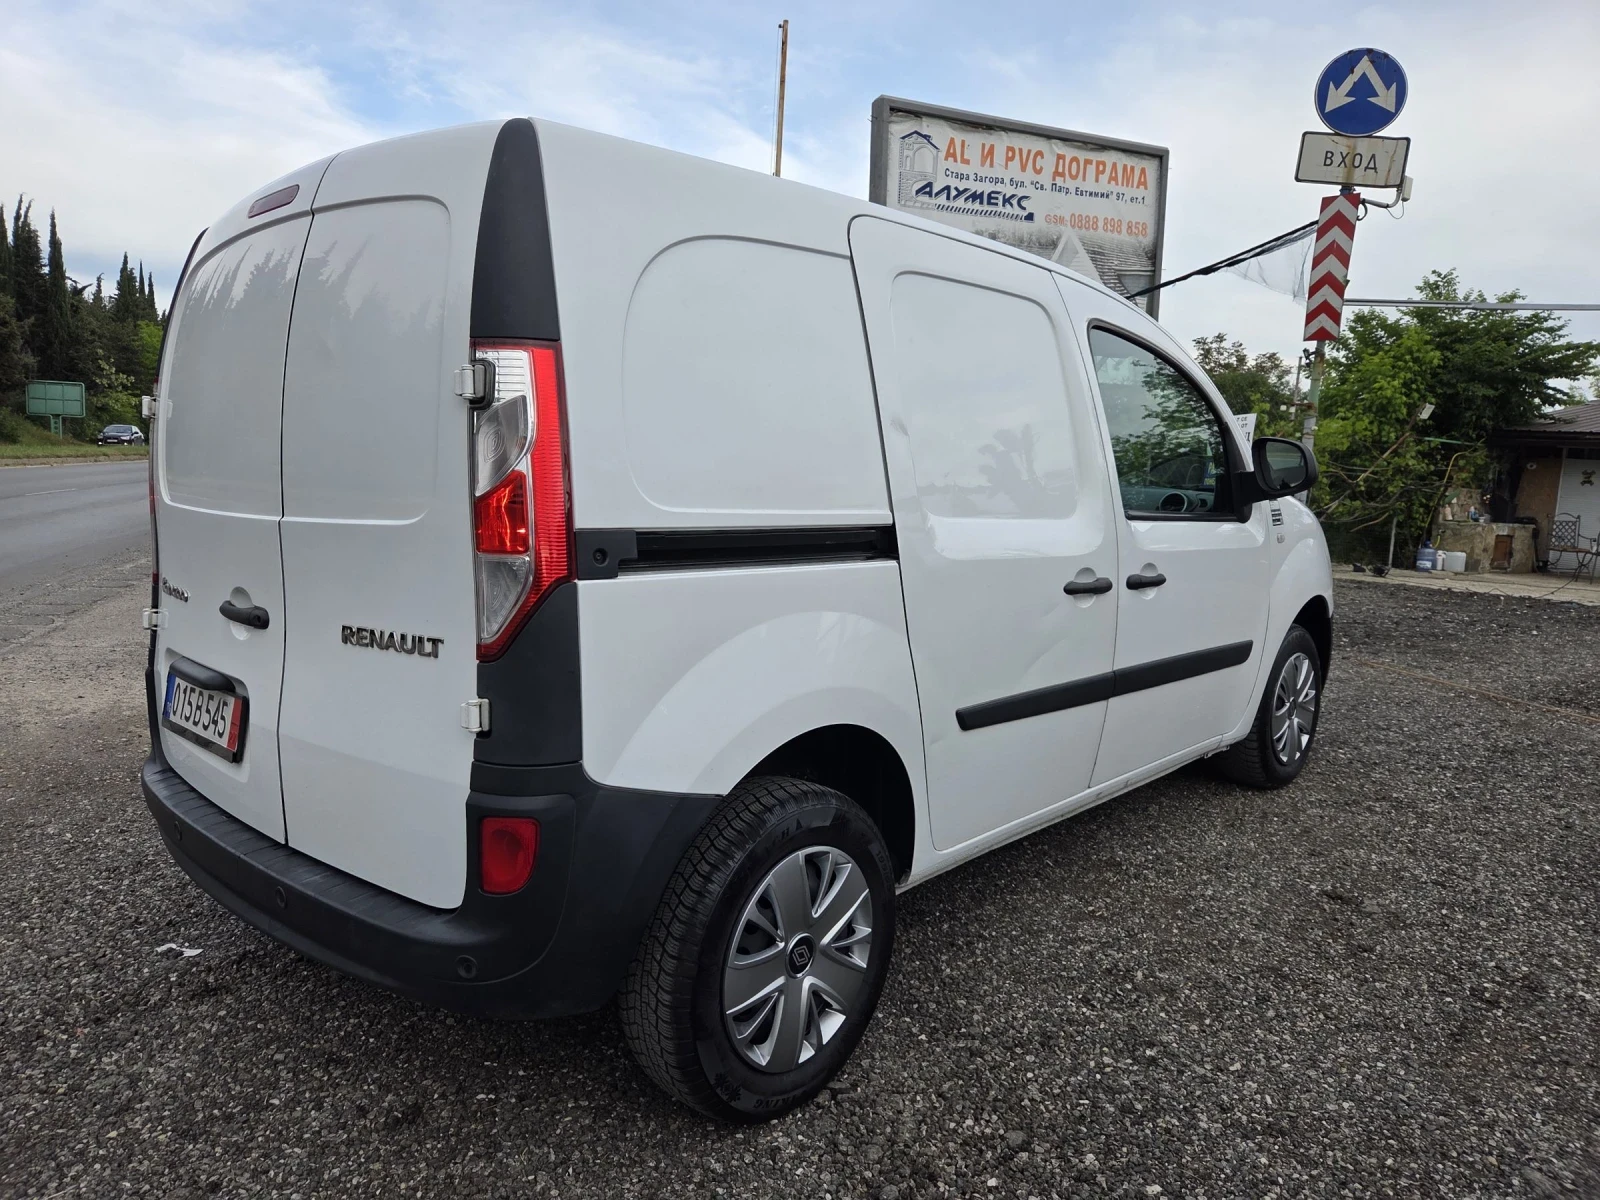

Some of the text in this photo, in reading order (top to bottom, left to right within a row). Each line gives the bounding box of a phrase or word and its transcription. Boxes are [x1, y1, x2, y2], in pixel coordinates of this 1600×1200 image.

[943, 136, 1149, 190] AL И PVC ДОГРАМА
[1323, 150, 1379, 173] ВХОД
[914, 181, 1032, 211] АЛУМЕКС
[944, 168, 970, 182] Стара
[973, 172, 1007, 187] Загора,
[1009, 177, 1027, 189] бул.
[1051, 182, 1072, 196] Патр.
[1115, 192, 1128, 204] 97,
[1044, 212, 1149, 239] GSM: 0888 898 858
[341, 624, 445, 659] RENAULT
[172, 682, 229, 739] 015B545
